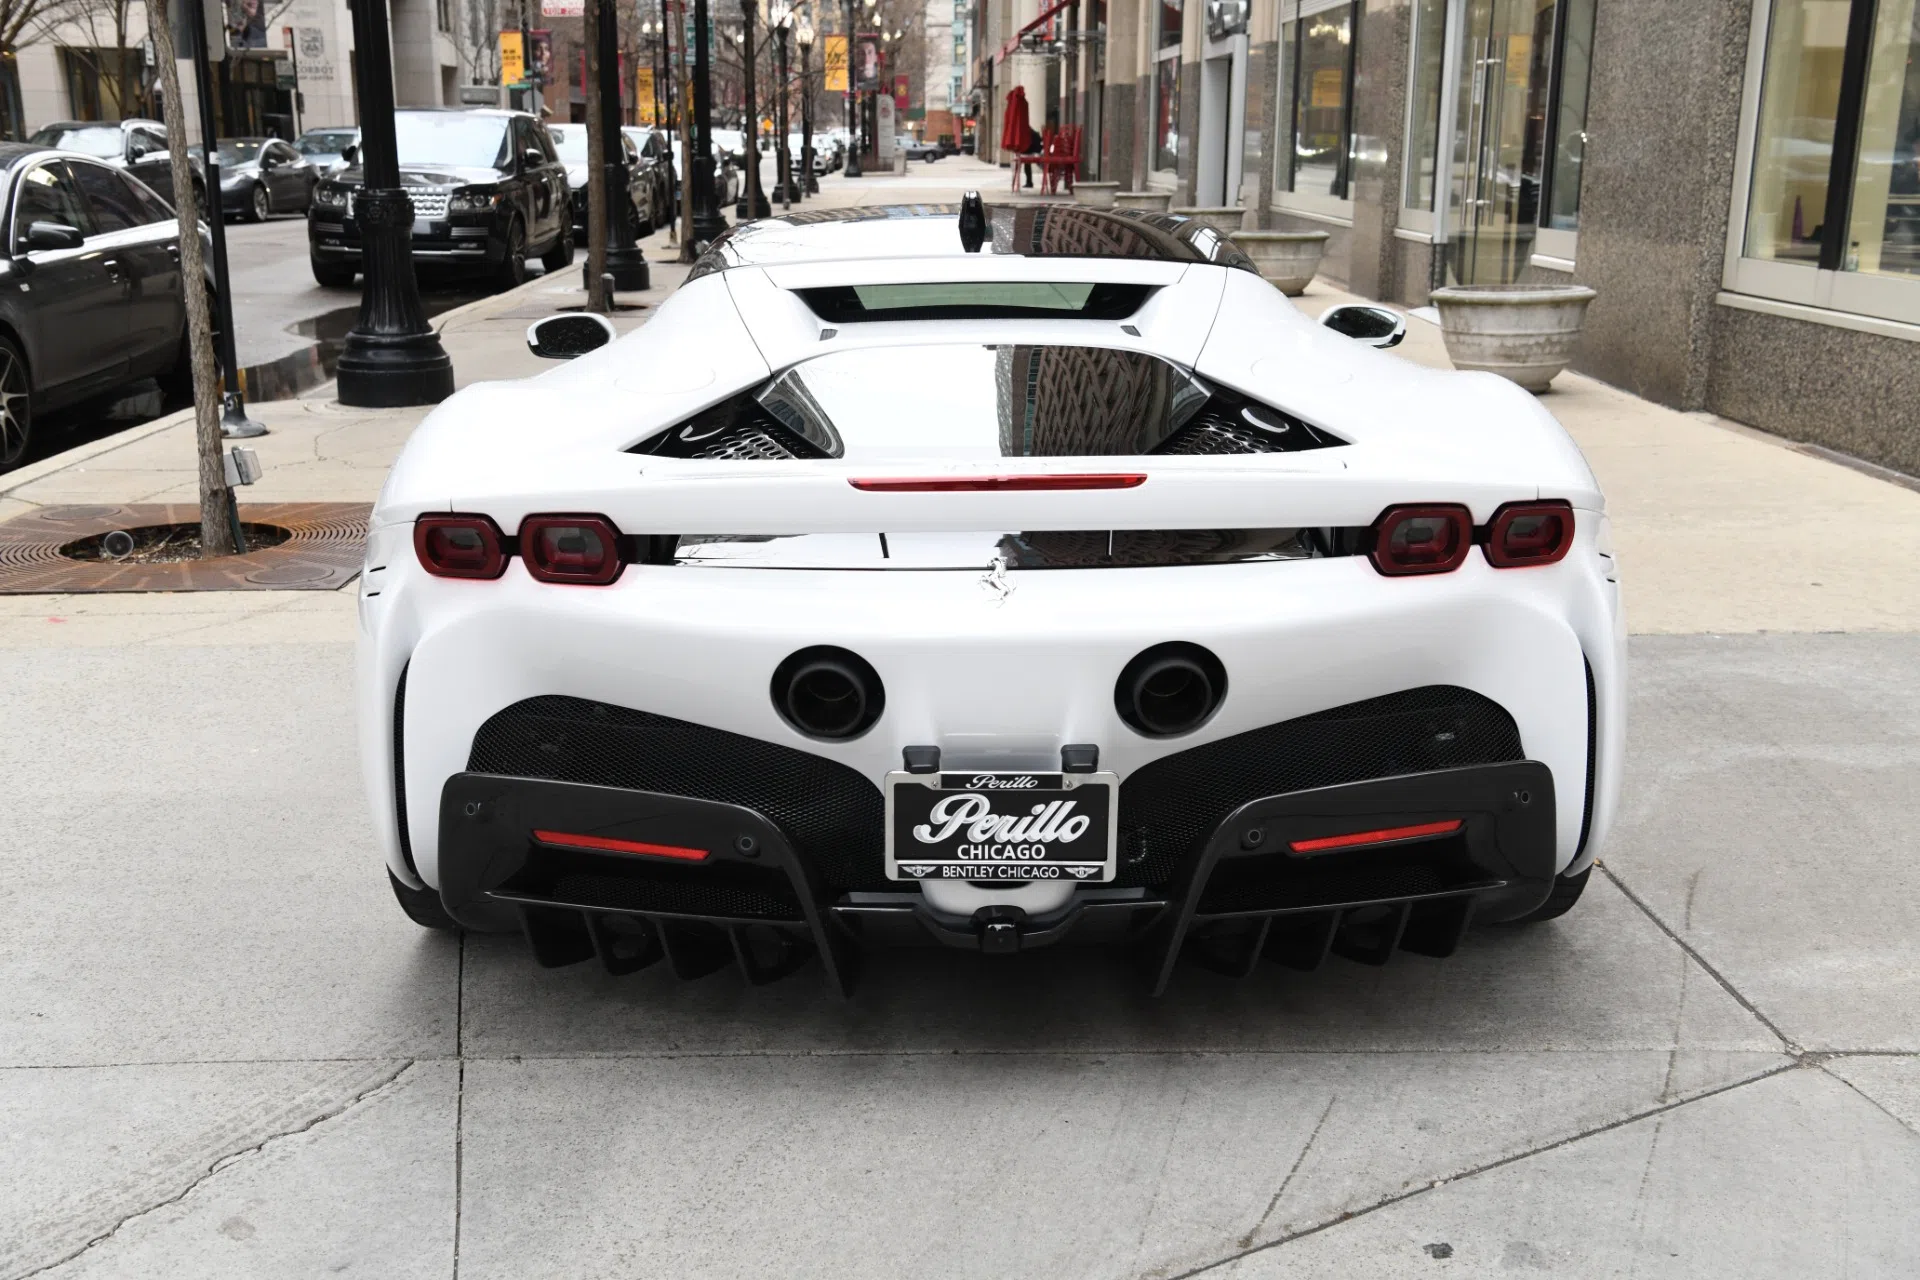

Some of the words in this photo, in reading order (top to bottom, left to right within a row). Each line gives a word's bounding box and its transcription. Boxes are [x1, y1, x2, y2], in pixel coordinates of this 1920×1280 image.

[965, 773, 1039, 789] Perillo
[913, 793, 1090, 844] Perillo
[957, 844, 1046, 860] CHICAGO
[942, 866, 996, 878] BENTLEY
[998, 866, 1060, 878] CHICAGO
